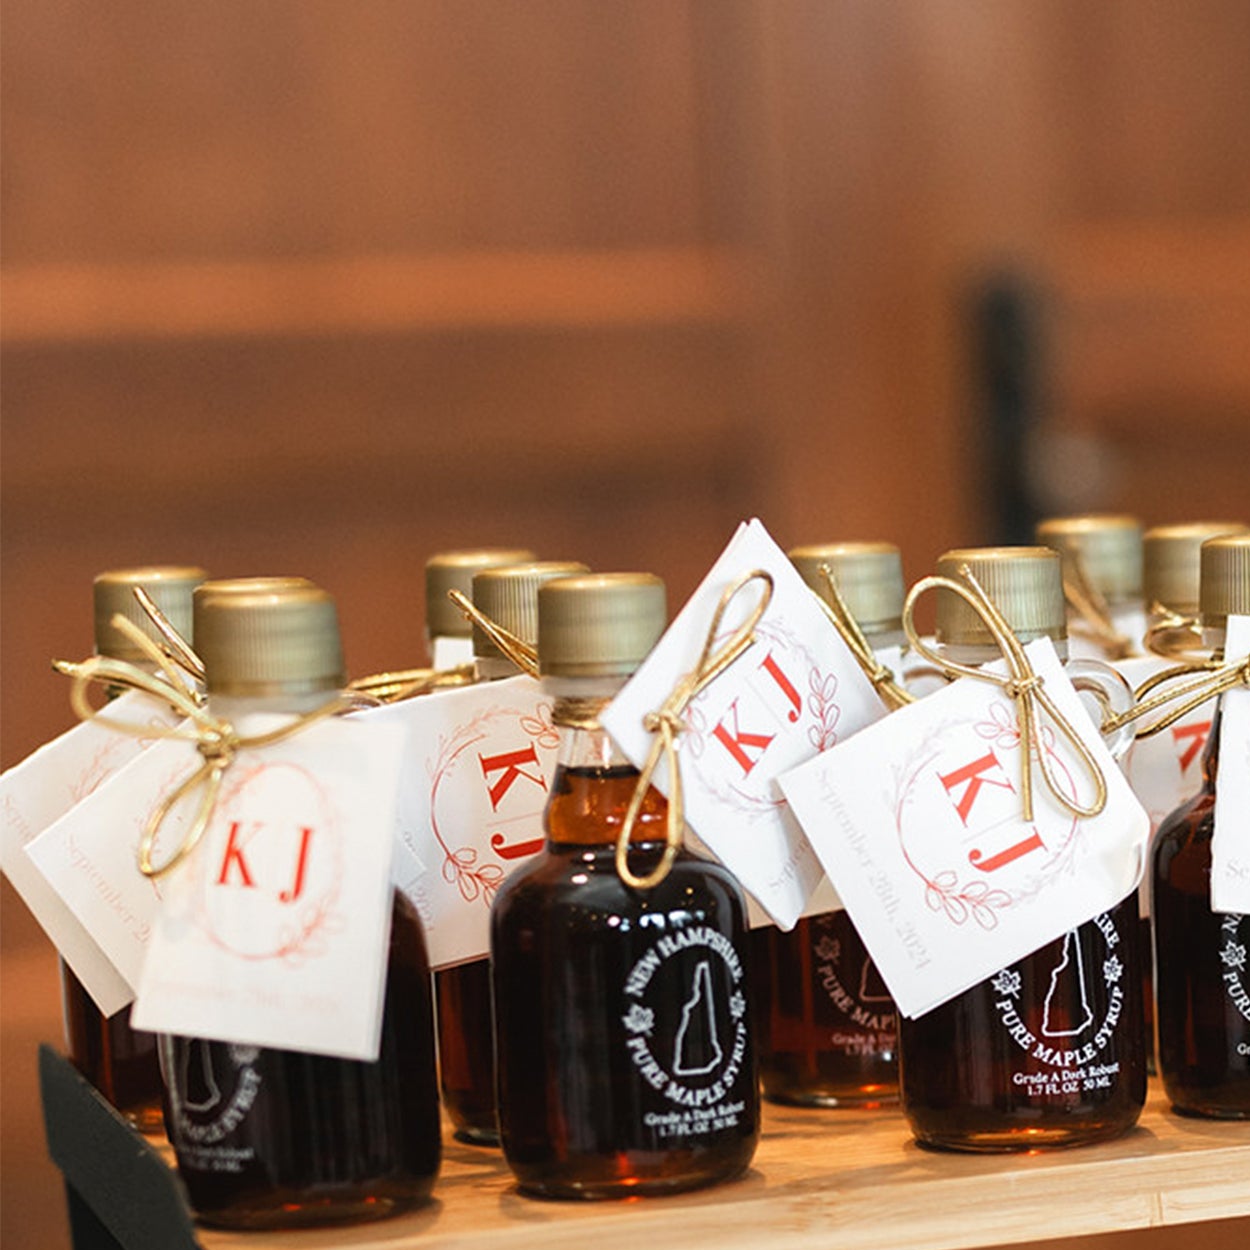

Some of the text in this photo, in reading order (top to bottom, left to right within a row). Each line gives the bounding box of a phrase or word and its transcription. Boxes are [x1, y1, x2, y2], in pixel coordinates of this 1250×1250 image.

[708, 649, 802, 780] K J
[478, 742, 548, 860] K J
[936, 746, 1049, 873] K J
[215, 822, 313, 903] K J
[816, 769, 872, 868] September
[896, 921, 930, 970] 2024
[624, 948, 661, 997] NEW
[818, 965, 854, 1013] PURE
[996, 986, 1124, 1067] PURE MAPLE SYRUP
[627, 1037, 669, 1089] PURE
[665, 1080, 726, 1106] MAPLE
[1013, 1073, 1048, 1085] Grade
[1051, 1073, 1061, 1083] A
[1062, 1068, 1088, 1081] Dark
[1027, 1084, 1043, 1096] 1.7
[1045, 1083, 1061, 1094] FL
[1062, 1081, 1079, 1093] OZ
